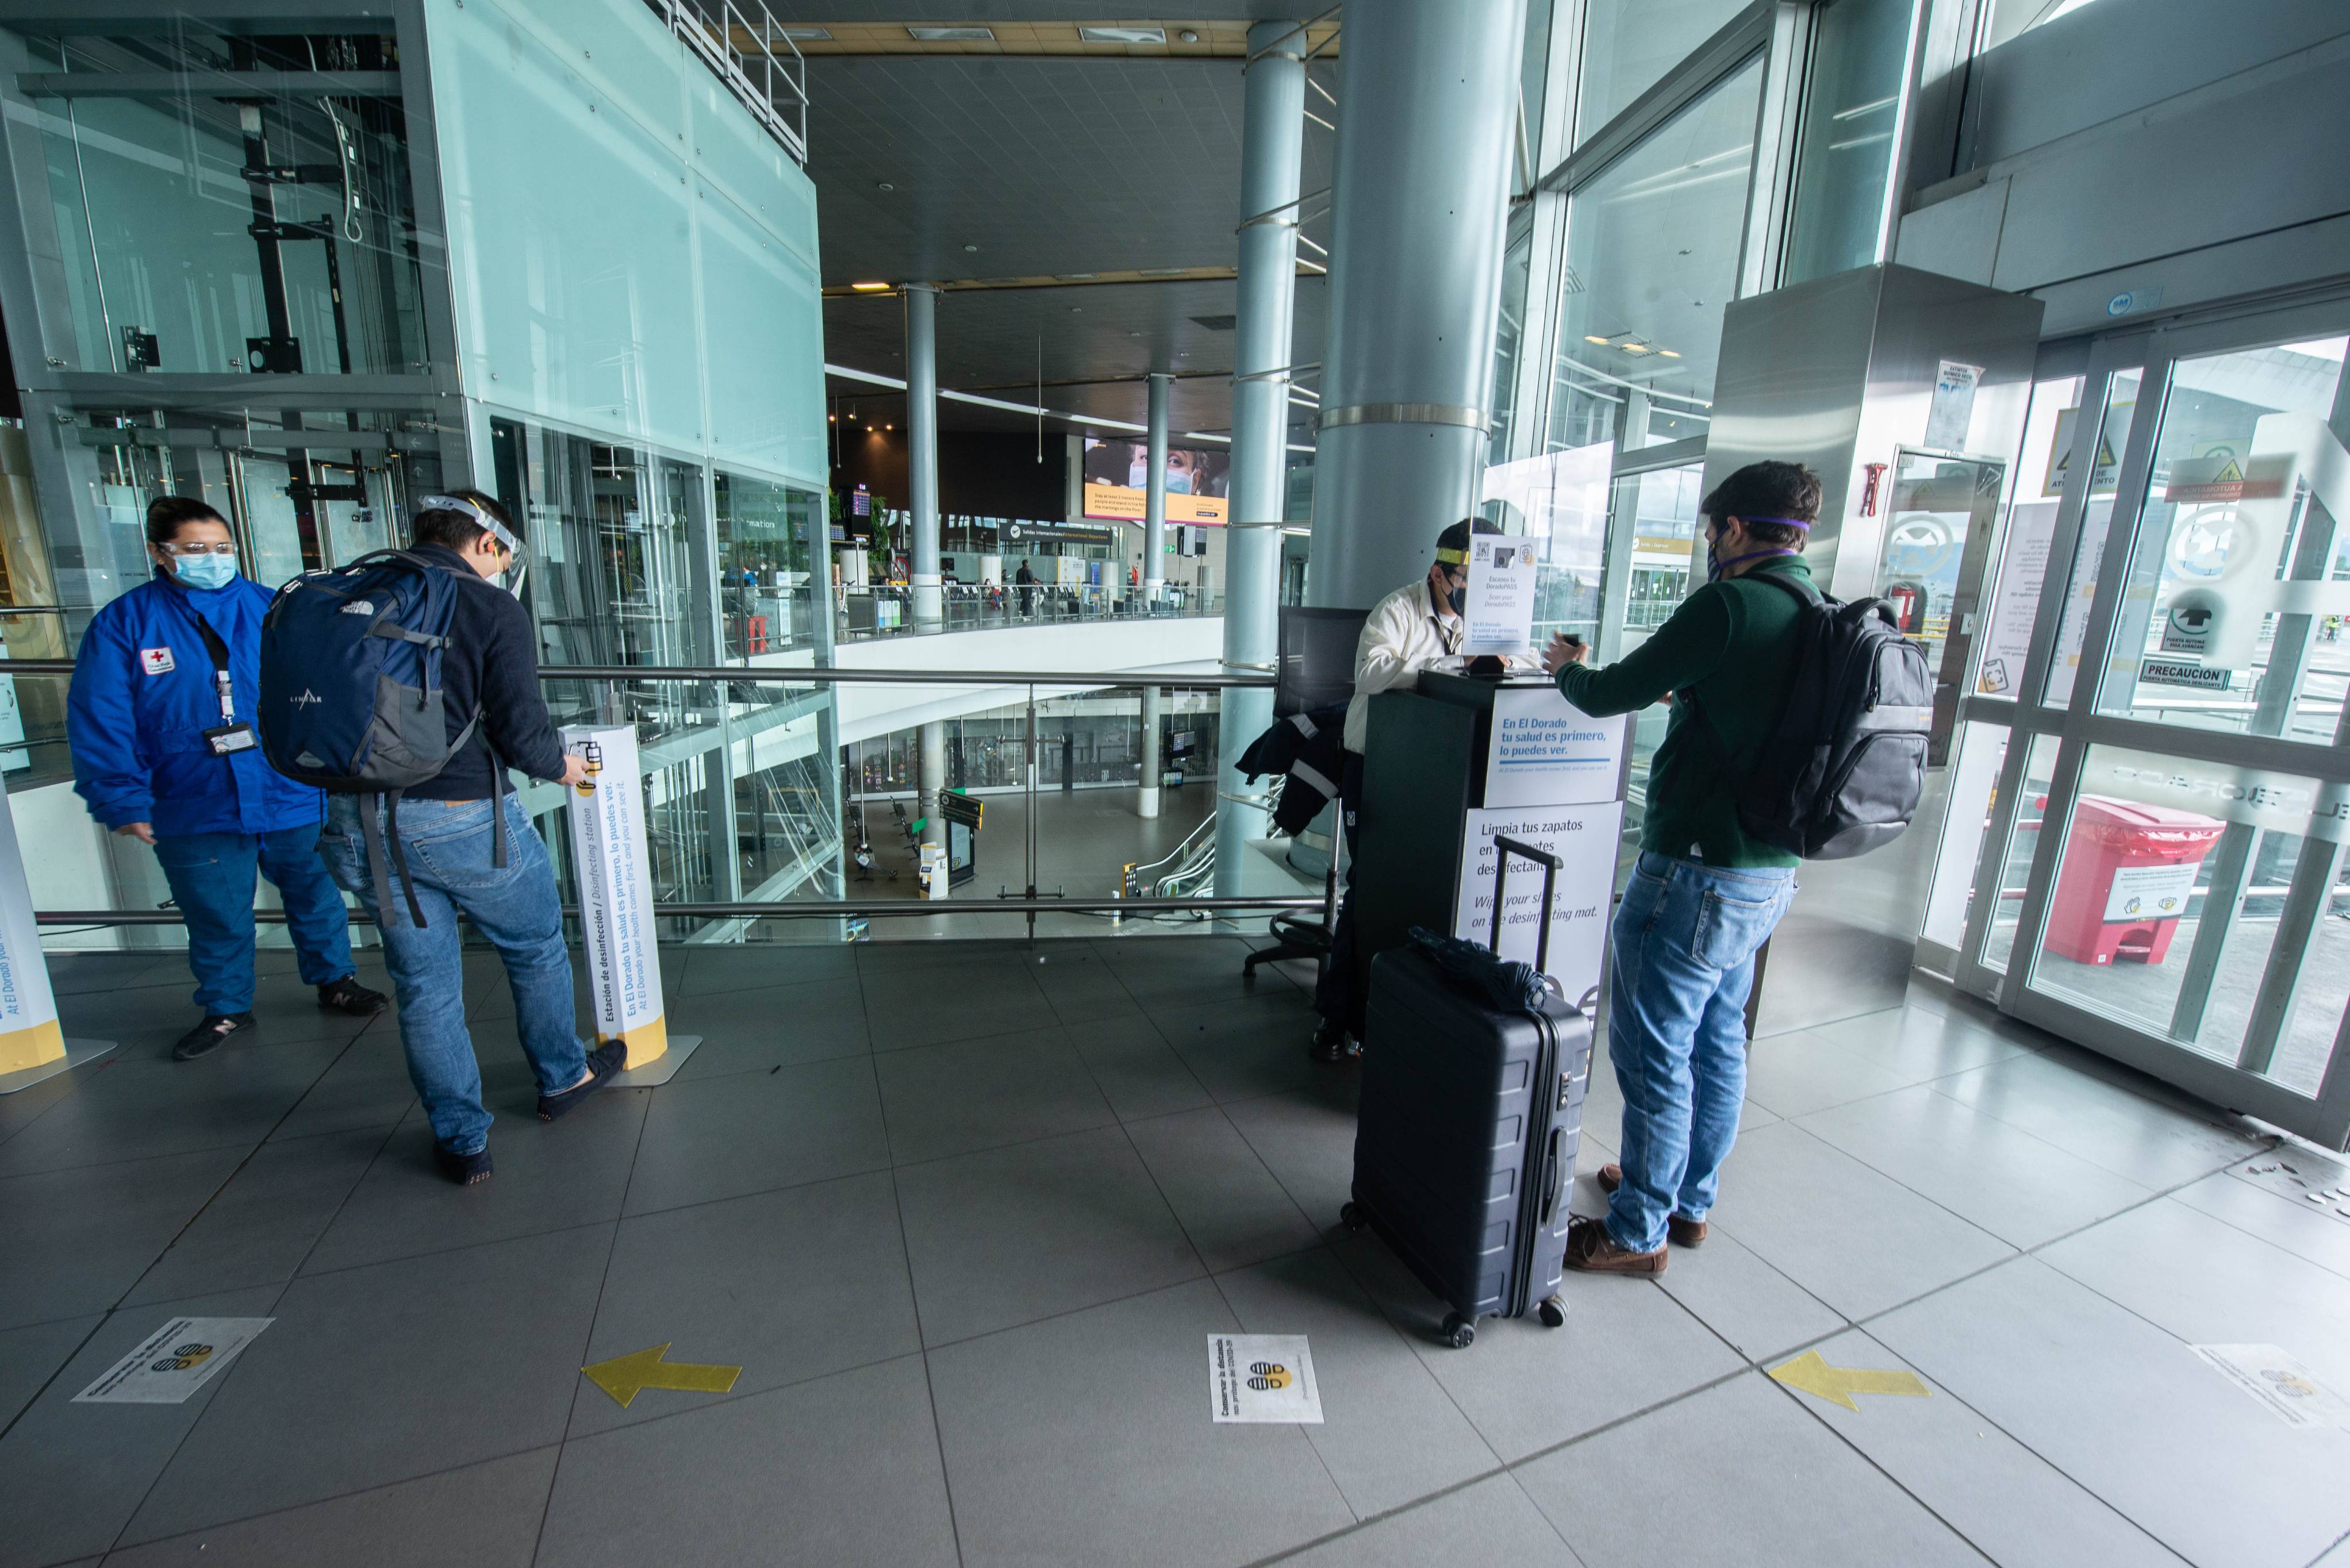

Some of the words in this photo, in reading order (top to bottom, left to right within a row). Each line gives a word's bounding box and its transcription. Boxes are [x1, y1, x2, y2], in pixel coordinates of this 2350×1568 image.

[1489, 575, 1510, 583] Escanea
[2148, 664, 2220, 681] PRECAUCIÓN
[2161, 677, 2191, 685] AUTOMÁTICA
[2191, 679, 2221, 688] DESLIZANTE
[1503, 718, 1516, 729] En
[1518, 718, 1528, 728] El
[1531, 717, 1567, 728] Dorado
[1502, 732, 1512, 743] tu
[1515, 731, 1542, 743] salud
[1545, 732, 1557, 741] es
[1560, 729, 1607, 744] primero,
[1499, 745, 1509, 756] lo
[1511, 744, 1547, 758] puedes
[1550, 747, 1568, 755] ver.
[604, 782, 613, 801] ver.
[619, 791, 627, 806] see
[606, 804, 620, 841] puedes
[621, 807, 629, 824] can
[583, 808, 594, 841] station
[1481, 822, 1519, 836] Limpia
[1522, 822, 1539, 833] tus
[1541, 819, 1583, 834] zapatos
[622, 826, 632, 842] you
[610, 843, 619, 854] lo
[623, 843, 632, 859] and
[1479, 845, 1493, 856] en
[588, 844, 601, 900] Disinfecting
[1477, 860, 1545, 876] desfectant
[613, 855, 626, 898] primero,
[627, 883, 638, 910] comes
[1474, 895, 1495, 909] Wip
[1503, 895, 1530, 909] your
[1531, 891, 1562, 904] shes
[617, 901, 626, 912] es
[630, 910, 640, 938] health
[1472, 917, 1486, 928] on
[1508, 908, 1572, 925] desinfting
[1574, 905, 1598, 919] mat.
[617, 913, 629, 941] salud
[595, 909, 608, 967] desinfección
[621, 943, 630, 954] tu
[635, 939, 644, 958] your
[0, 962, 15, 993] Dorado
[601, 971, 609, 981] de
[621, 955, 633, 991] Dorado
[636, 959, 646, 988] Dorado
[3, 994, 17, 1003] El
[625, 992, 635, 1003] El
[638, 990, 646, 998] El
[7, 1004, 20, 1015] At
[602, 983, 615, 1023] Estación
[627, 1003, 636, 1017] En
[639, 1000, 647, 1011] At
[1216, 1338, 1225, 1369] distancia
[1219, 1370, 1226, 1378] la
[1221, 1379, 1230, 1417] Conservar
